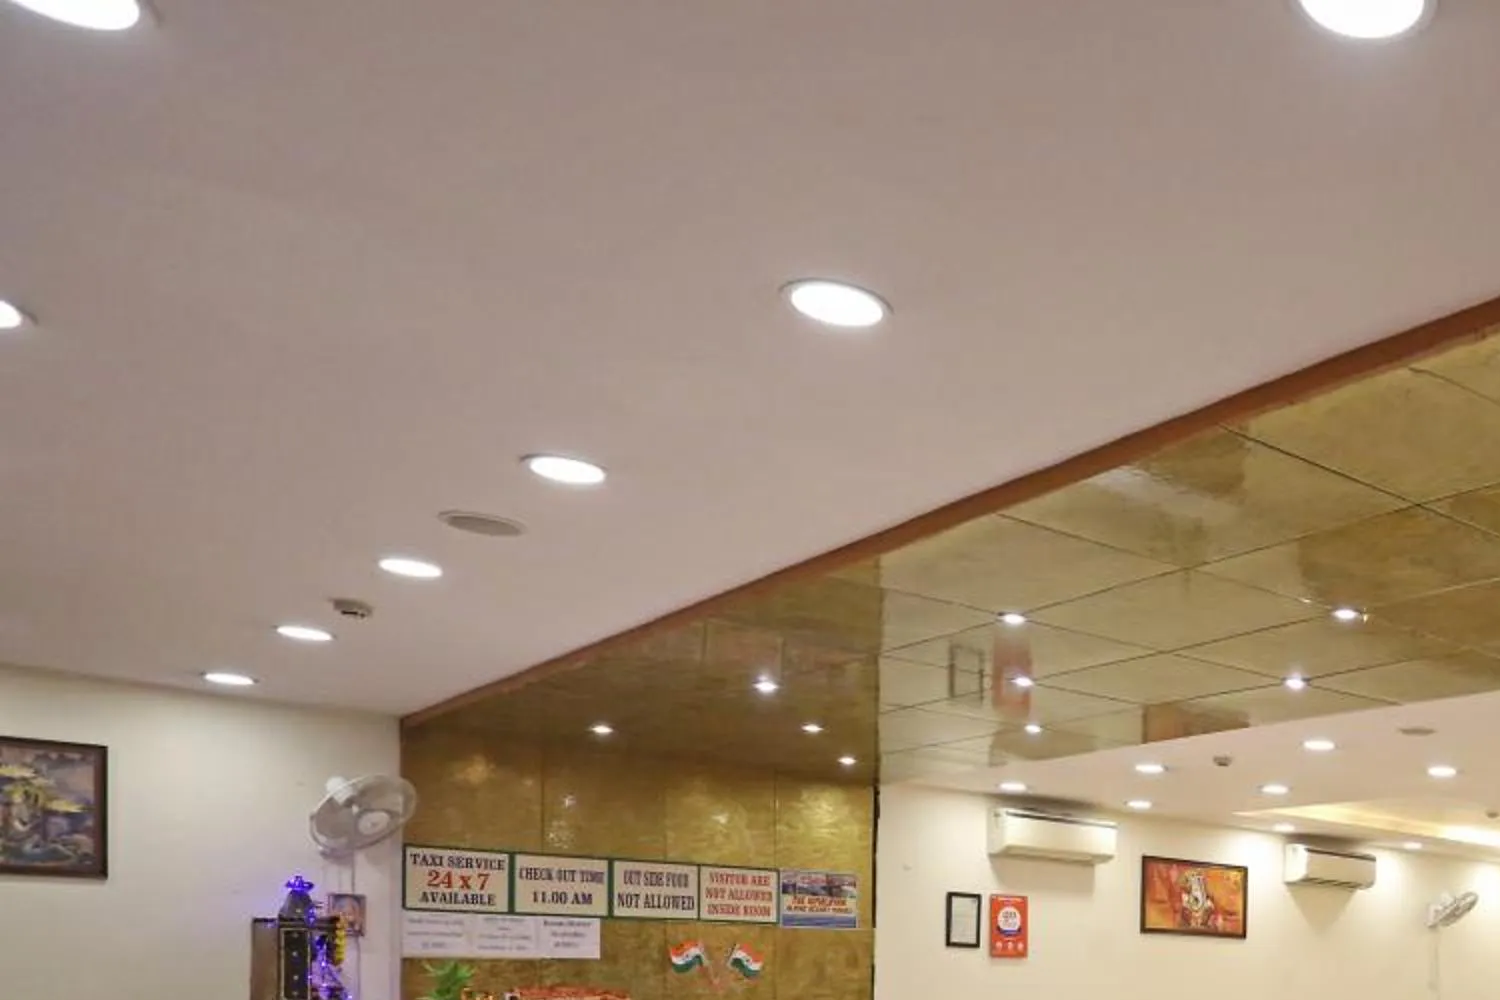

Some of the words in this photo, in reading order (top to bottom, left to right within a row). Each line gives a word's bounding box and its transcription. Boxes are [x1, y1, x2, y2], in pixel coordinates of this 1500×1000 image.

[410, 853, 444, 867] TAXI
[447, 856, 505, 870] SERVICE
[427, 869, 453, 889] 24
[477, 873, 490, 890] 7
[519, 867, 553, 881] CHECK
[557, 868, 576, 882] OUT
[419, 891, 496, 906] AVAILABLE
[571, 892, 593, 905] AM
[705, 887, 726, 899] NOT
[617, 893, 640, 909] NOT
[643, 893, 695, 911] ALLOWED
